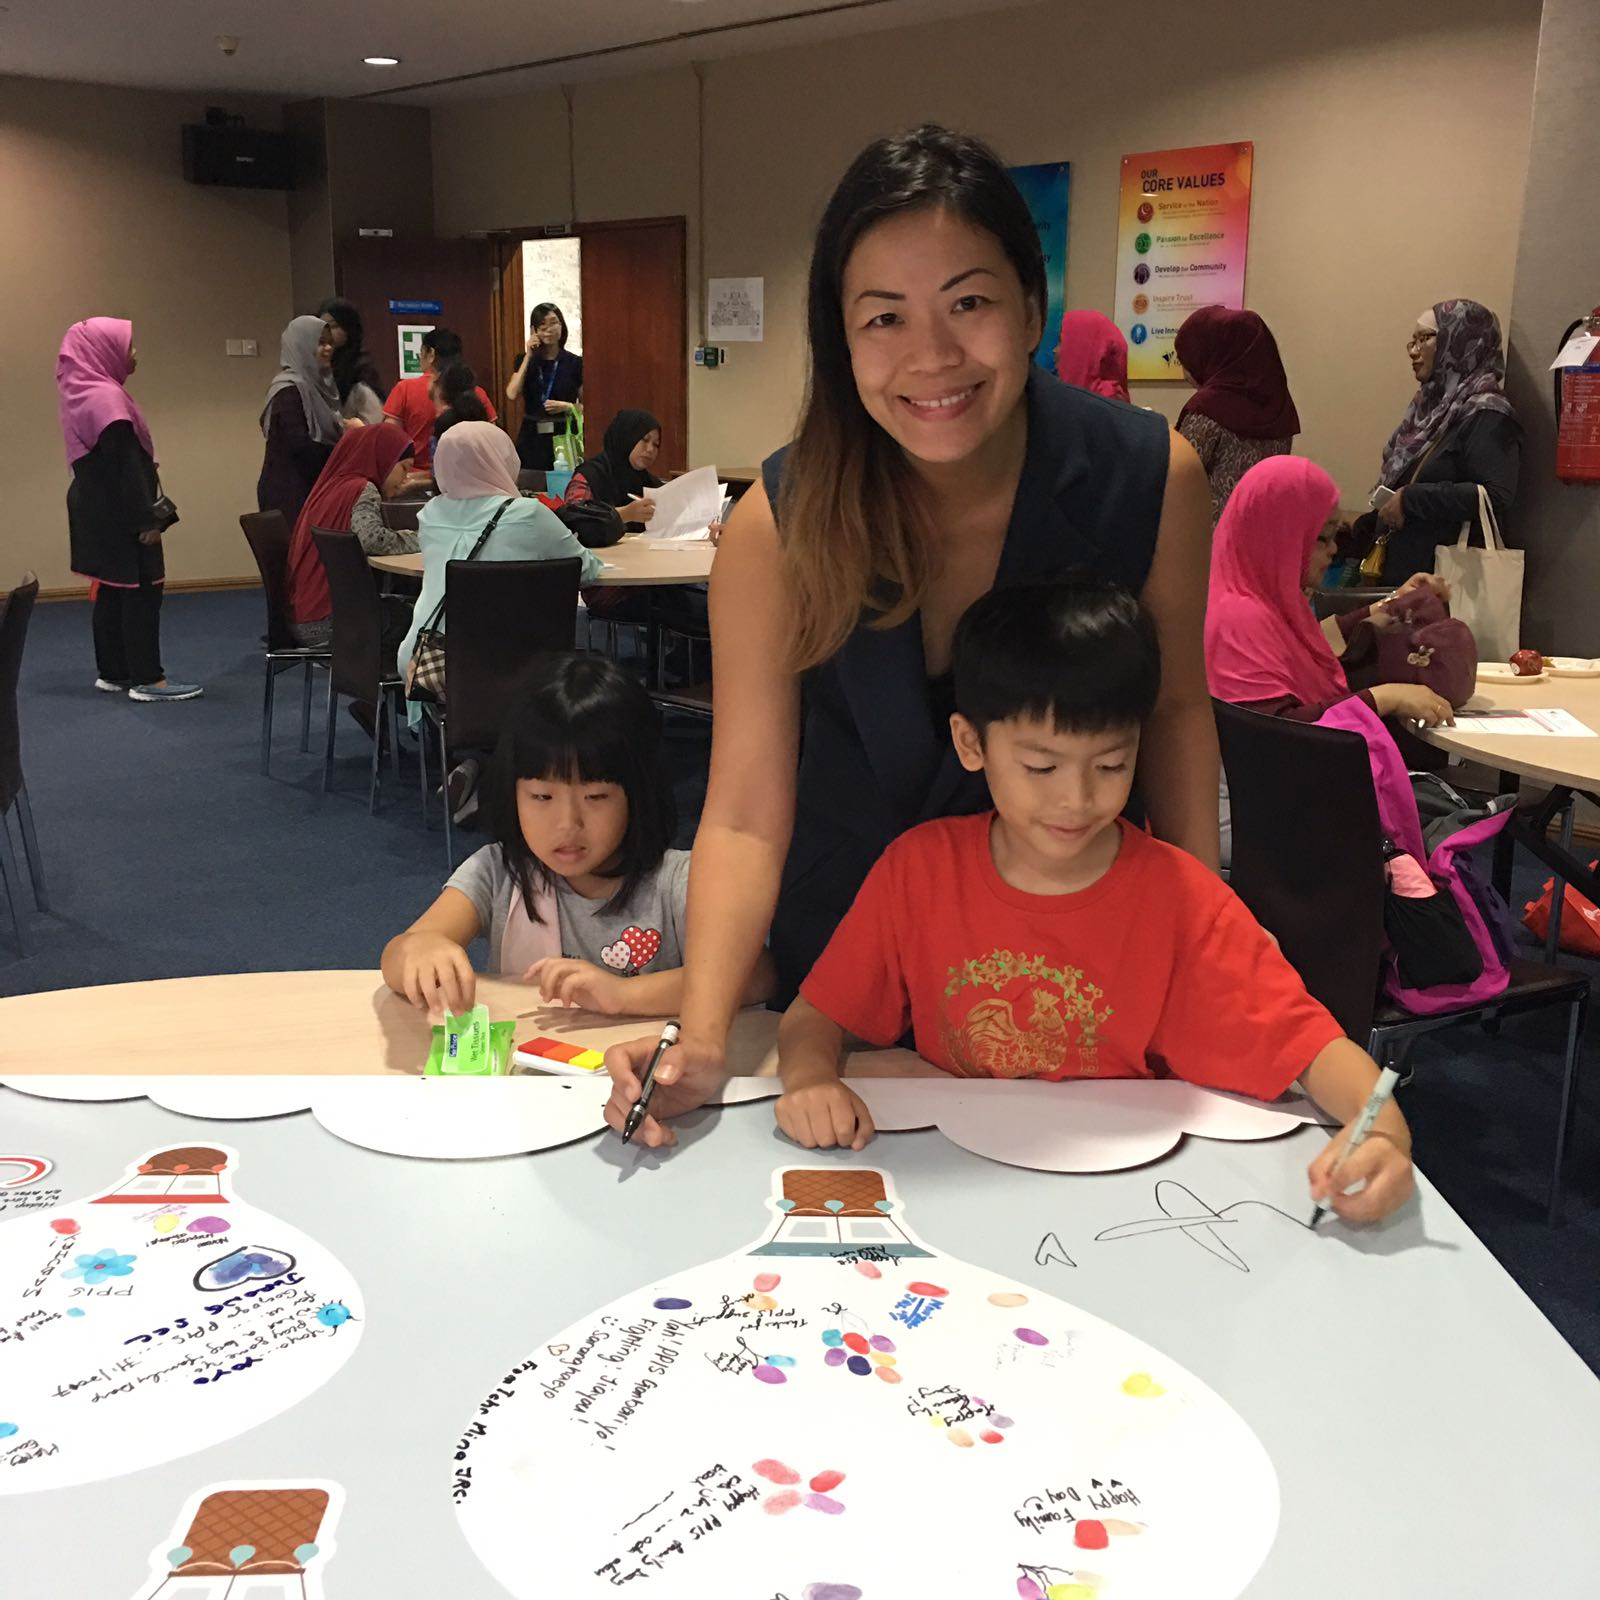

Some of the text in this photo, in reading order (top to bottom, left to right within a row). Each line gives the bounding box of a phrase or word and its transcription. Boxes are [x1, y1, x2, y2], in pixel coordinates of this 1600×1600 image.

[1141, 169, 1158, 179] OUR
[1142, 172, 1226, 193] CORE VALUES
[1158, 202, 1182, 210] Service
[1197, 199, 1219, 207] Nation
[1156, 235, 1181, 243] Passion
[1189, 232, 1225, 241] Excellence
[1155, 265, 1180, 273] Develop
[1189, 263, 1227, 272] Community
[1153, 294, 1175, 302] Inspire
[471, 1020, 480, 1050] Tissues
[68, 1284, 134, 1298] PPIS
[757, 1307, 796, 1318] PPIS
[648, 1344, 680, 1376] PPIS
[502, 1359, 539, 1385] From
[1046, 1486, 1082, 1505] Day
[1087, 1488, 1142, 1511] Happy
[689, 1512, 723, 1541] PPIS
